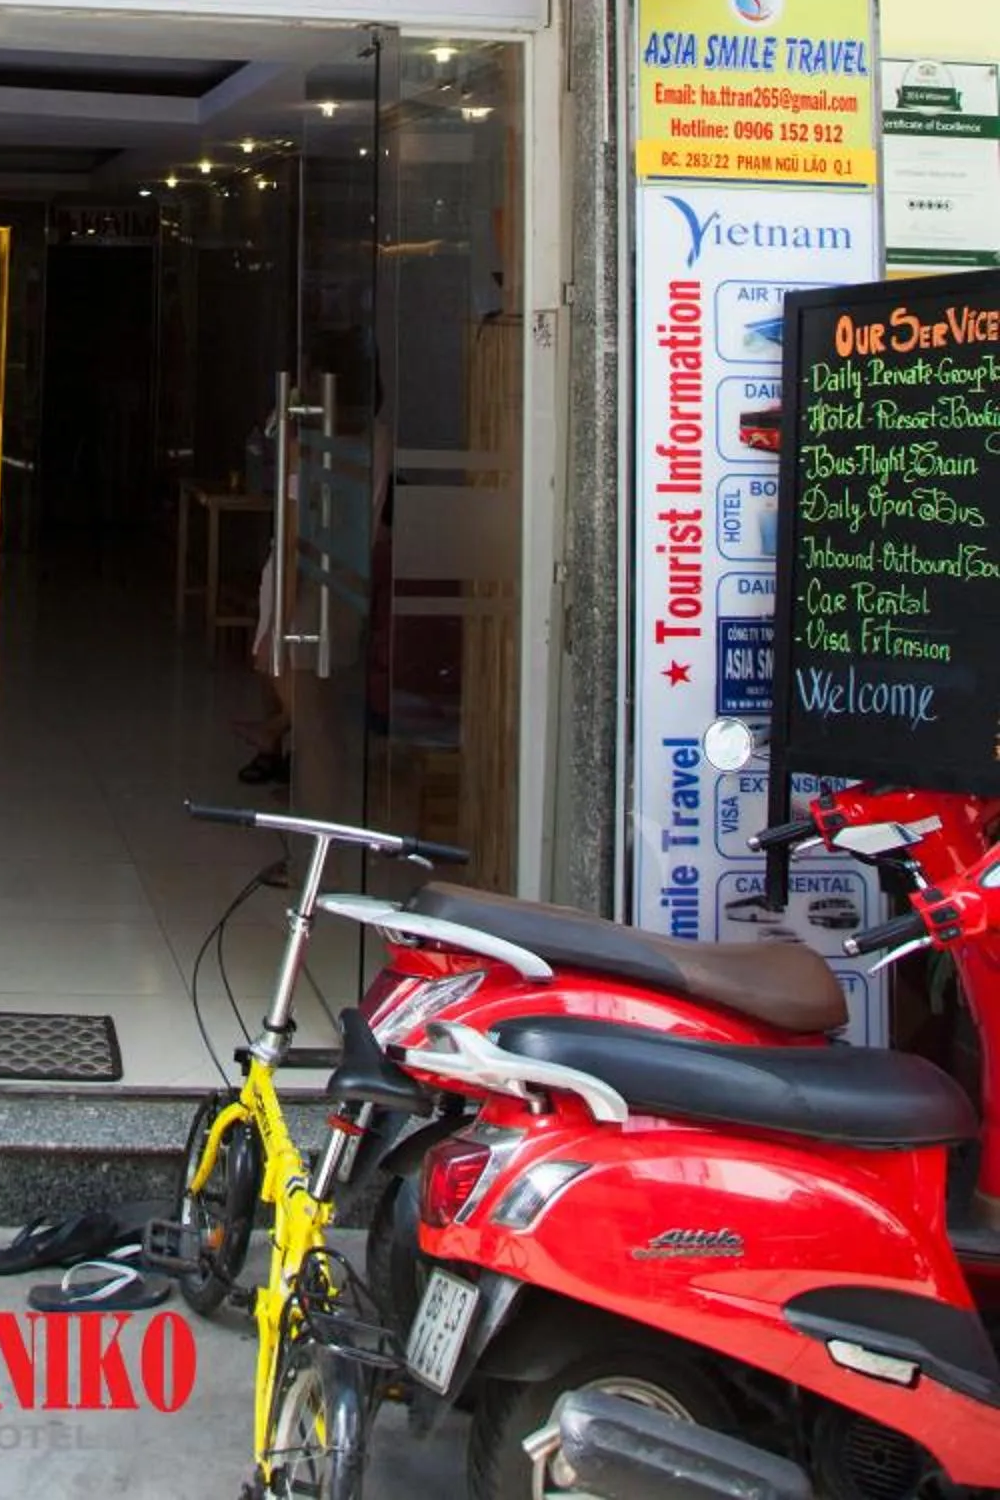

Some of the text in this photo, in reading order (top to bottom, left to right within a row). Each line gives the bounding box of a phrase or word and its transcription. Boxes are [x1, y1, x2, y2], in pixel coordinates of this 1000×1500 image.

[643, 31, 869, 77] ASIA SMILE TRAVEL
[655, 82, 697, 105] Email:
[671, 118, 844, 143] Hotline: 0906 152 912
[663, 194, 853, 268] Vietnam
[737, 287, 769, 302] AIR
[656, 280, 703, 494] Information
[744, 383, 783, 400] DAI
[811, 358, 862, 399] Daily
[808, 397, 866, 438] Hotel
[723, 488, 742, 543] HOTEL
[799, 482, 868, 534] Daily
[654, 508, 704, 645] Tourist
[737, 579, 777, 595] DAIL
[725, 647, 755, 681] ASIA
[795, 665, 938, 731] Welcome
[661, 736, 700, 853] Travel
[720, 795, 739, 835] VISA
[660, 864, 700, 942] mile
[735, 876, 857, 893] CA ENTAL
